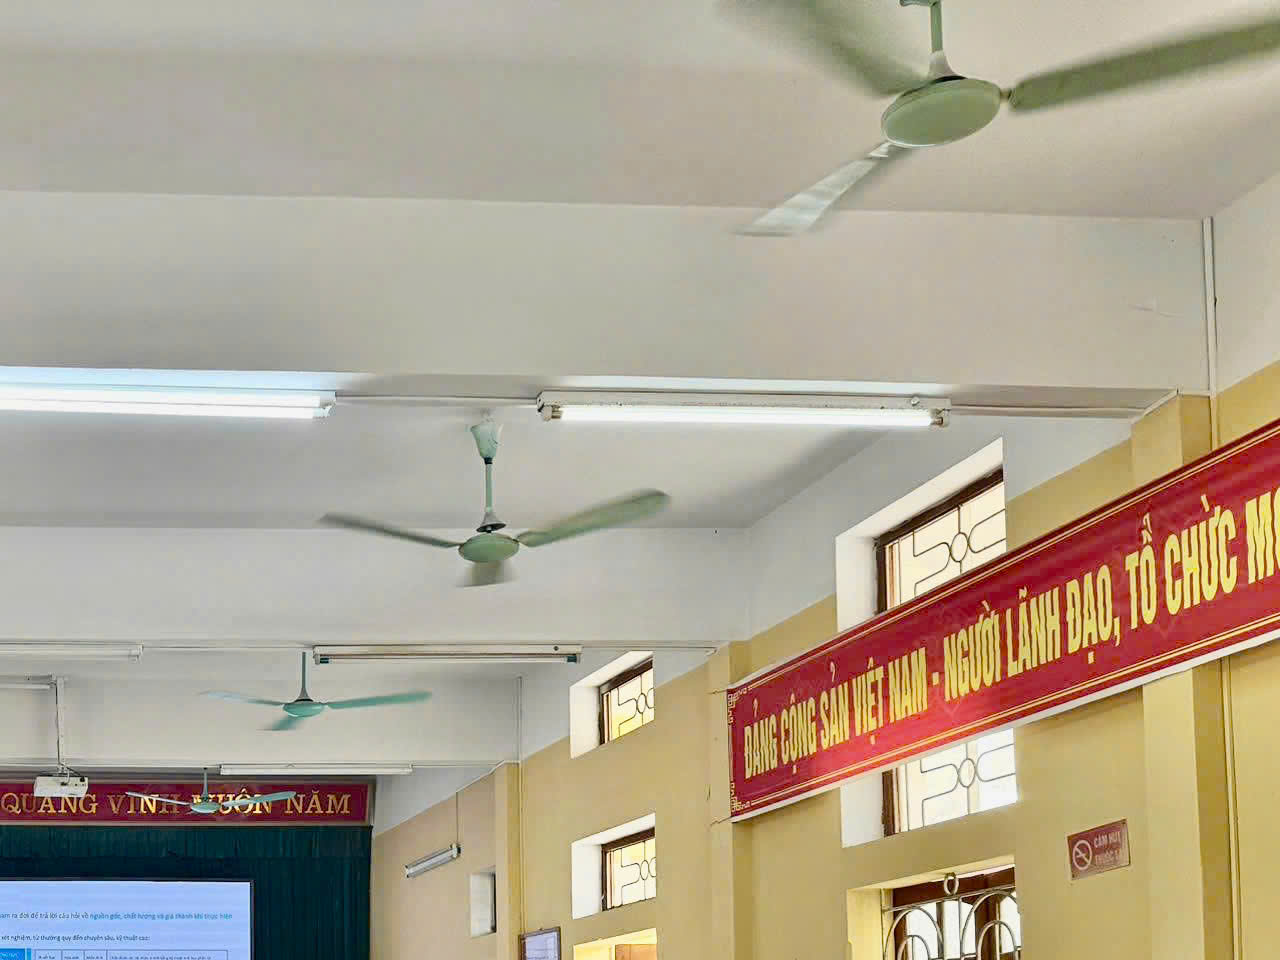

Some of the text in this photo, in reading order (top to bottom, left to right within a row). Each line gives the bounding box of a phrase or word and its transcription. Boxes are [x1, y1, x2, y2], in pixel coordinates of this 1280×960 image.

[744, 698, 777, 780] ĐẢNG
[780, 692, 817, 775] CỘNG
[820, 661, 850, 750] SẢN
[852, 656, 884, 745] VIỆT
[887, 647, 928, 724] NAM
[943, 600, 1002, 702] NGƯỜI
[1005, 585, 1061, 678] LÃNH
[1066, 564, 1120, 664] ĐẠO,
[1125, 512, 1157, 630] TỔ
[0, 792, 98, 815] QUANG
[107, 791, 180, 814] VINH
[284, 789, 351, 815] NĂM
